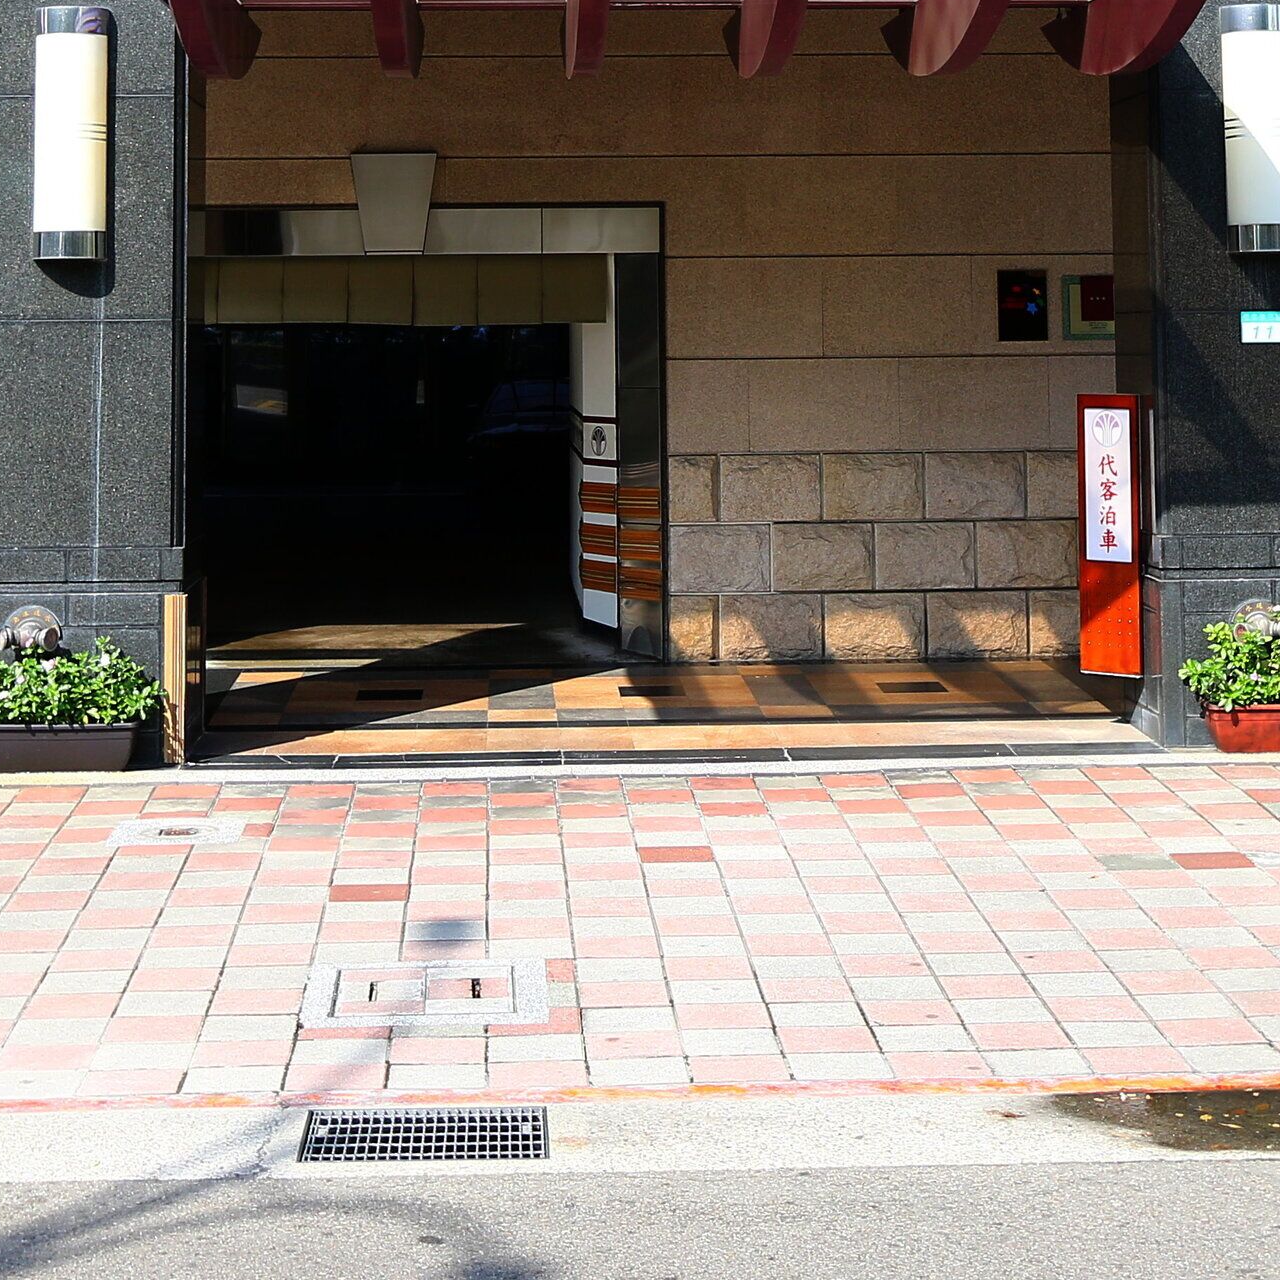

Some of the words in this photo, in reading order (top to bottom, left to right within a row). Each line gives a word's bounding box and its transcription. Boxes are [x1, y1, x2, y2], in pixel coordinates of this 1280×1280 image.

[1253, 325, 1272, 340] 11
[1098, 453, 1118, 553] 代客泊車
